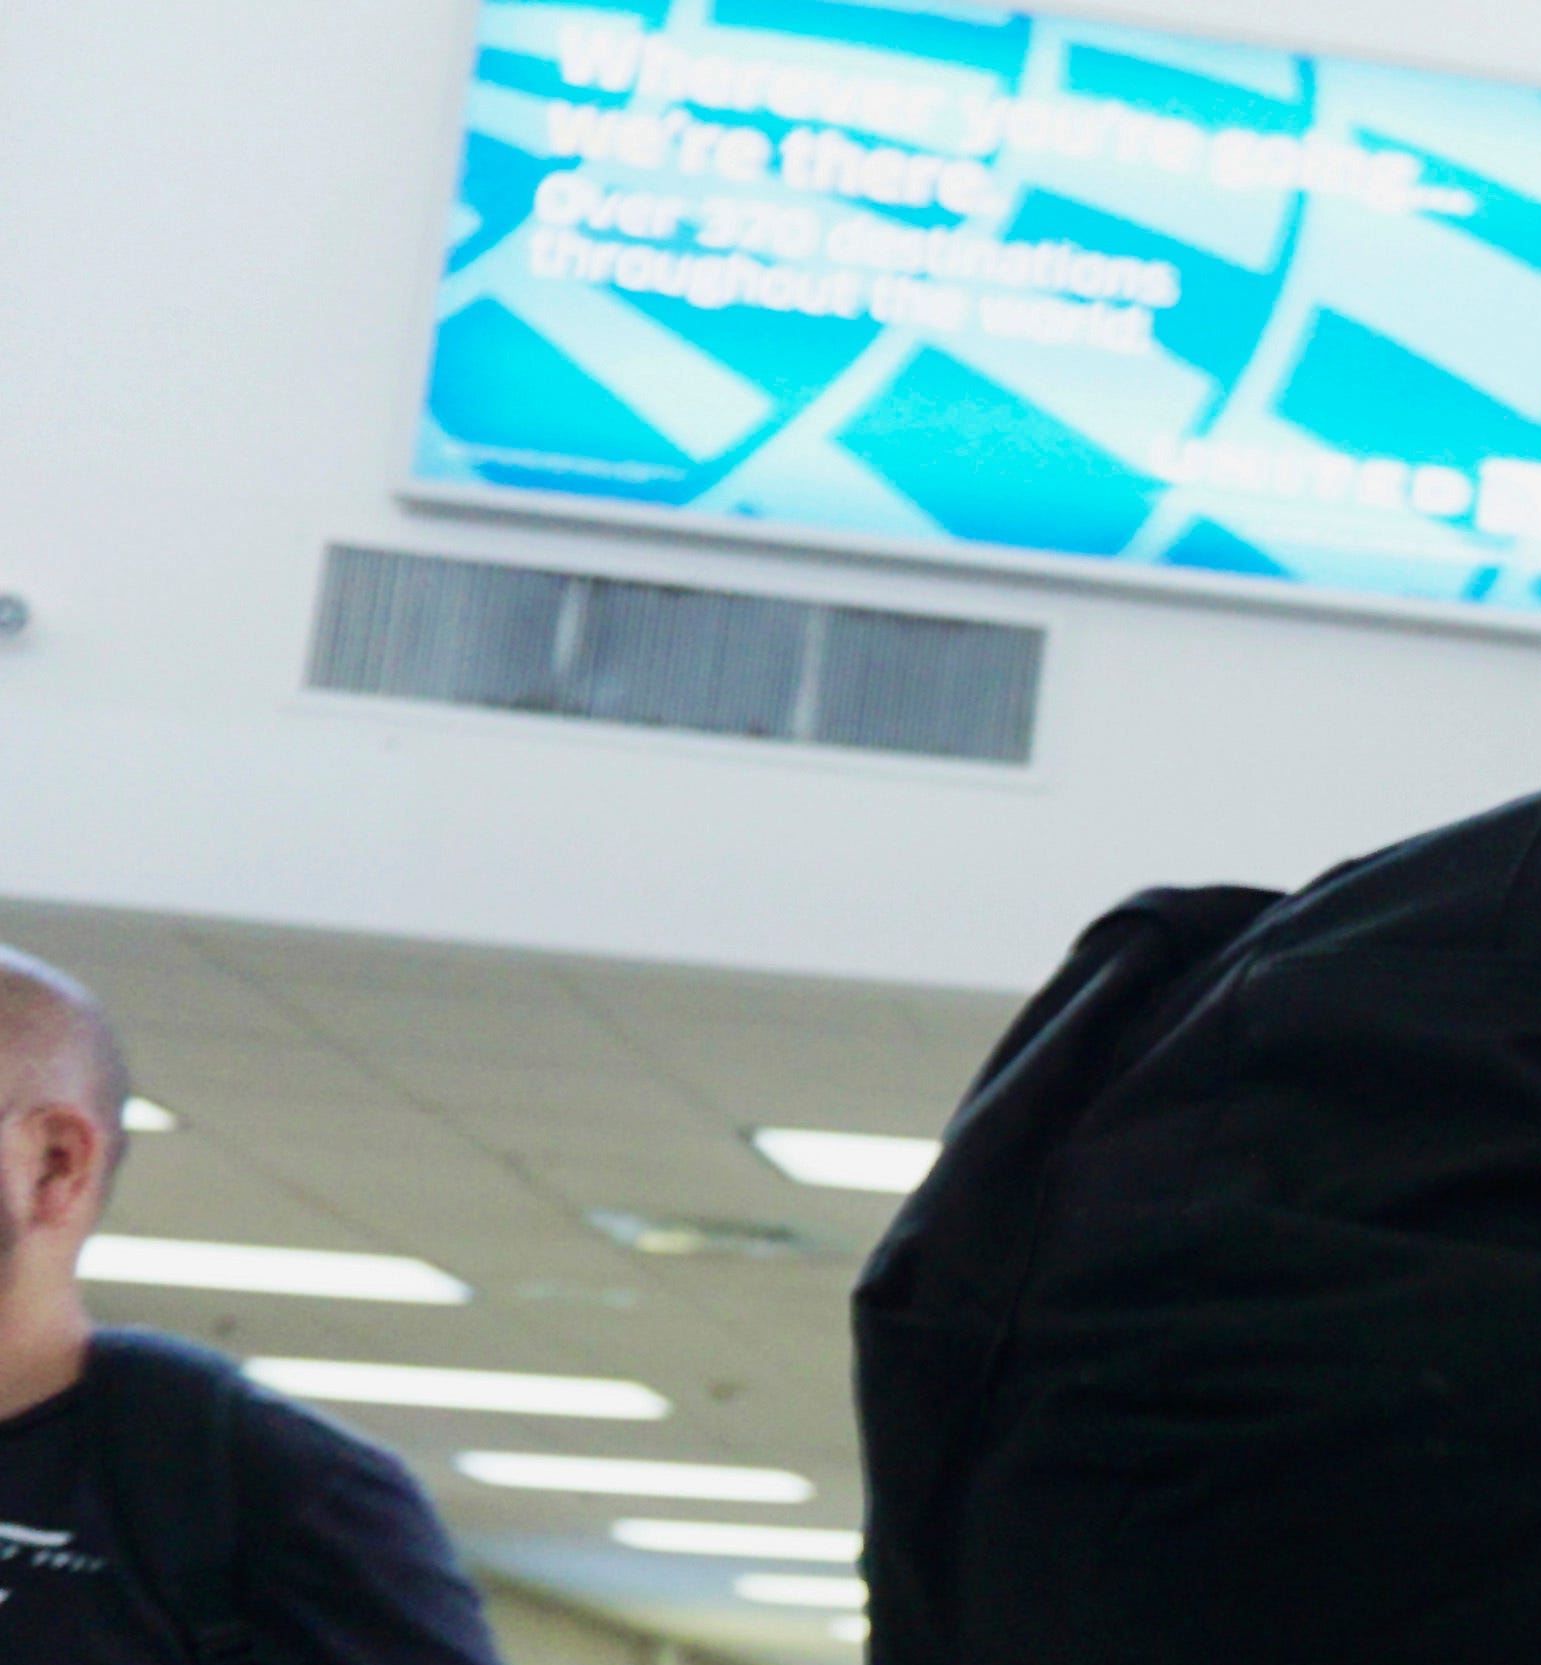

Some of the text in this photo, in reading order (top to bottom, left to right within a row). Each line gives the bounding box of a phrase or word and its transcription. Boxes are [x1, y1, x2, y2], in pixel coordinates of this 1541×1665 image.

[548, 103, 768, 179] we're
[554, 20, 947, 133] Wherever
[957, 90, 1203, 175] you're
[530, 229, 861, 310] throughout
[871, 275, 970, 331] the
[534, 174, 686, 232] Over
[826, 218, 1179, 309] destinations
[1149, 430, 1471, 516] UNITED
